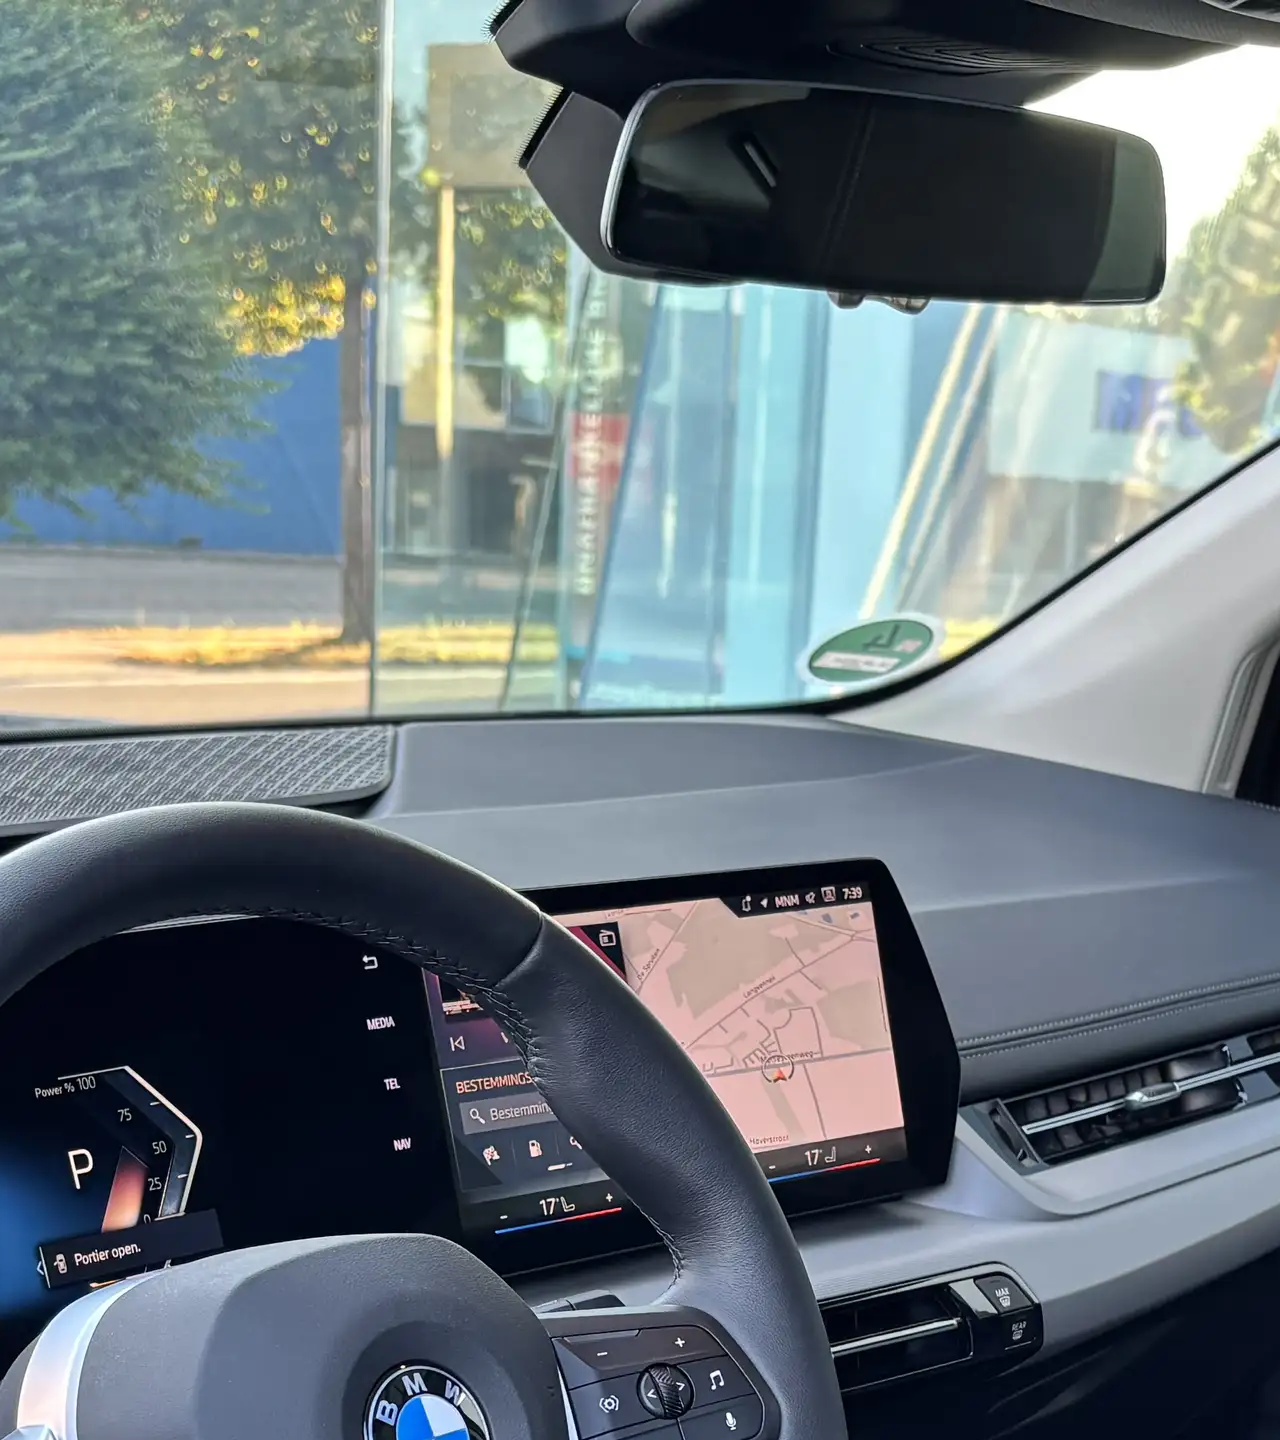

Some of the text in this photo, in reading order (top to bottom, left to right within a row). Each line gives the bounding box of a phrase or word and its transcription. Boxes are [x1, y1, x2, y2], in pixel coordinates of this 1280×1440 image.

[775, 886, 863, 908] MNM 7:39
[366, 1015, 396, 1031] MEDIA
[34, 1075, 96, 1099] Power % 100
[383, 1077, 401, 1091] TEL
[117, 1107, 132, 1122] 75
[152, 1140, 167, 1155] 50
[393, 1137, 412, 1151] NAV
[68, 1148, 94, 1190] P
[148, 1176, 162, 1191] 25
[74, 1242, 141, 1267] Portier open.
[995, 1287, 1010, 1297] MAX
[1012, 1320, 1027, 1332] REAR
[376, 1372, 467, 1427] BMW
